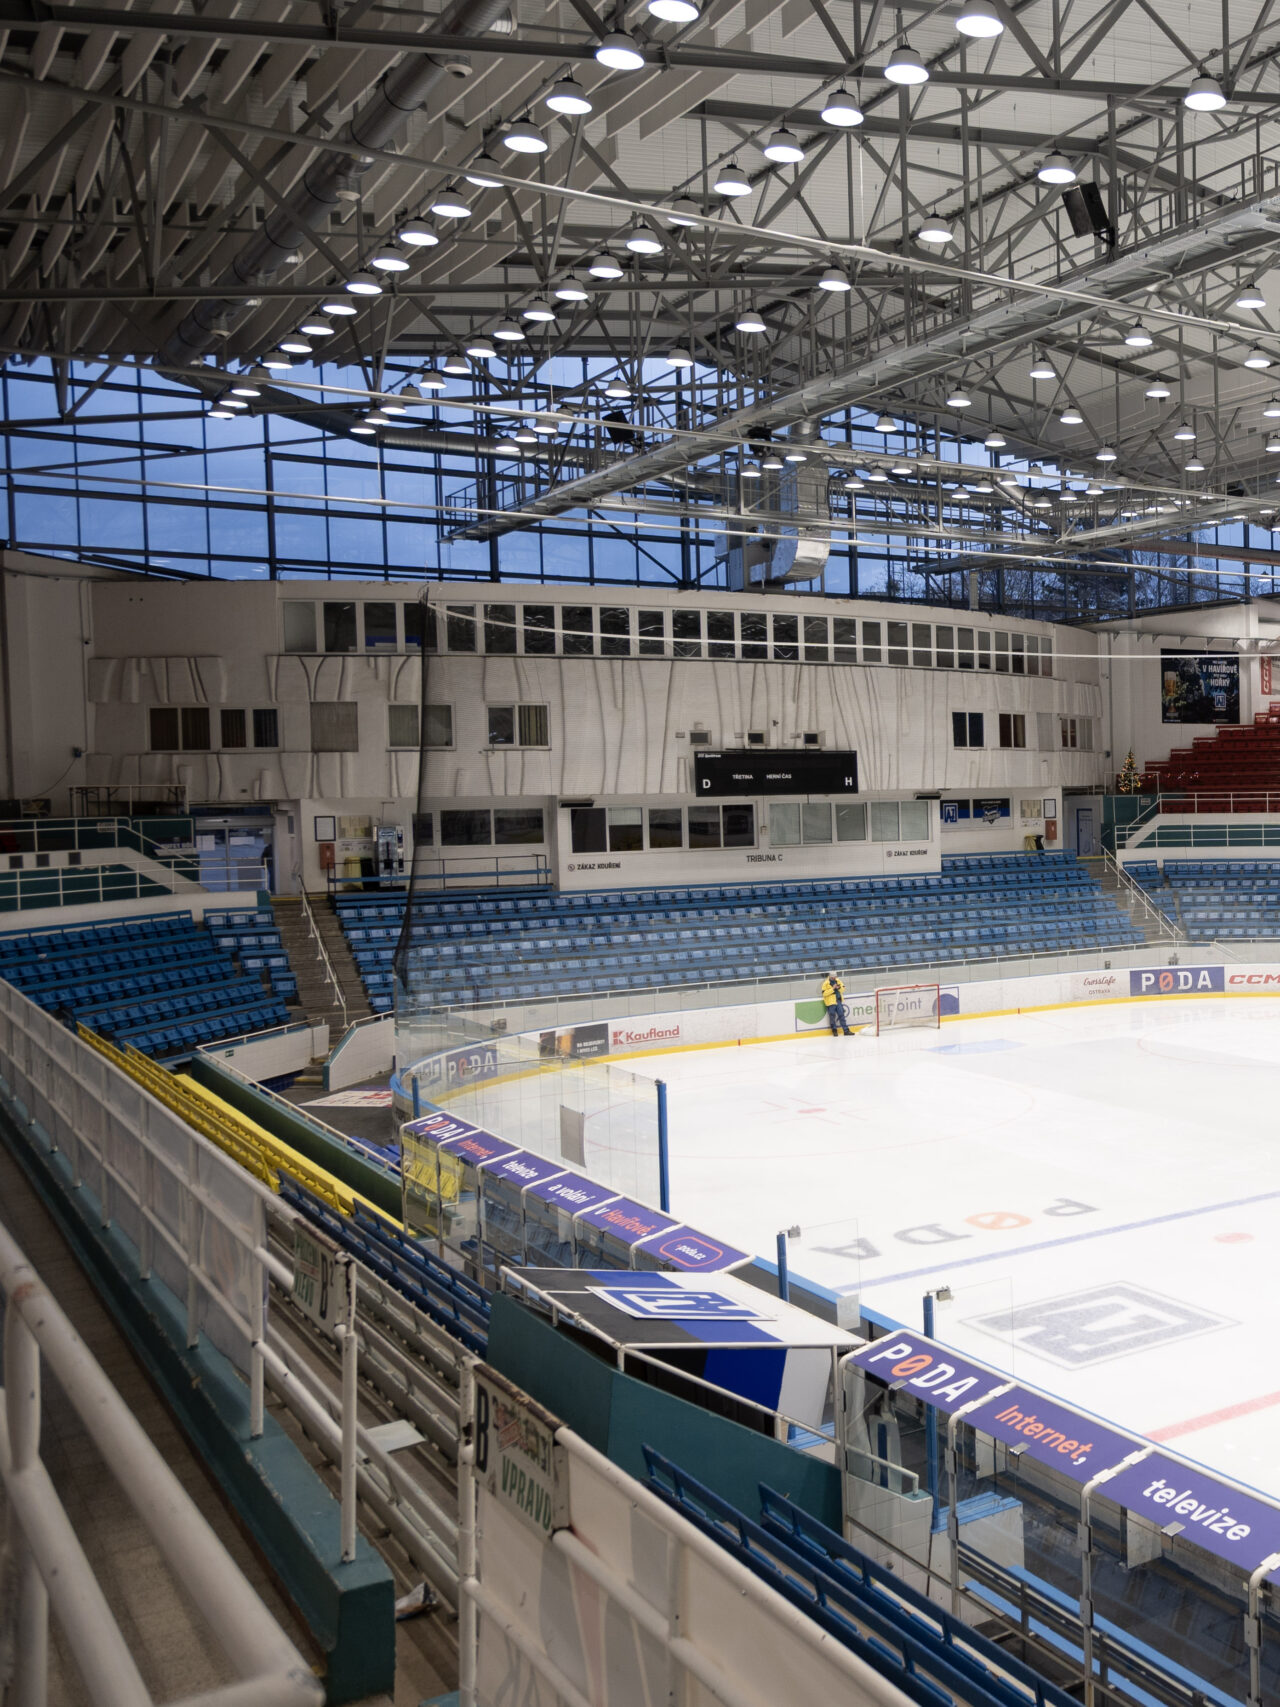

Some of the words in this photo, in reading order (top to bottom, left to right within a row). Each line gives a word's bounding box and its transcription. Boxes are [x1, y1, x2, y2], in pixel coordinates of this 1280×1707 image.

[702, 779, 711, 789] D
[844, 776, 853, 786] H
[777, 854, 783, 862] C
[577, 863, 596, 871] ZÁKAZ
[626, 1025, 680, 1042] Kaufland
[456, 1137, 496, 1159] Internet,
[502, 1159, 539, 1180] televize
[548, 1183, 556, 1192] a
[599, 1206, 609, 1216] v
[995, 1405, 1093, 1466] Internet,
[502, 1454, 552, 1531] VPRAVO
[1142, 1478, 1252, 1542] televize
